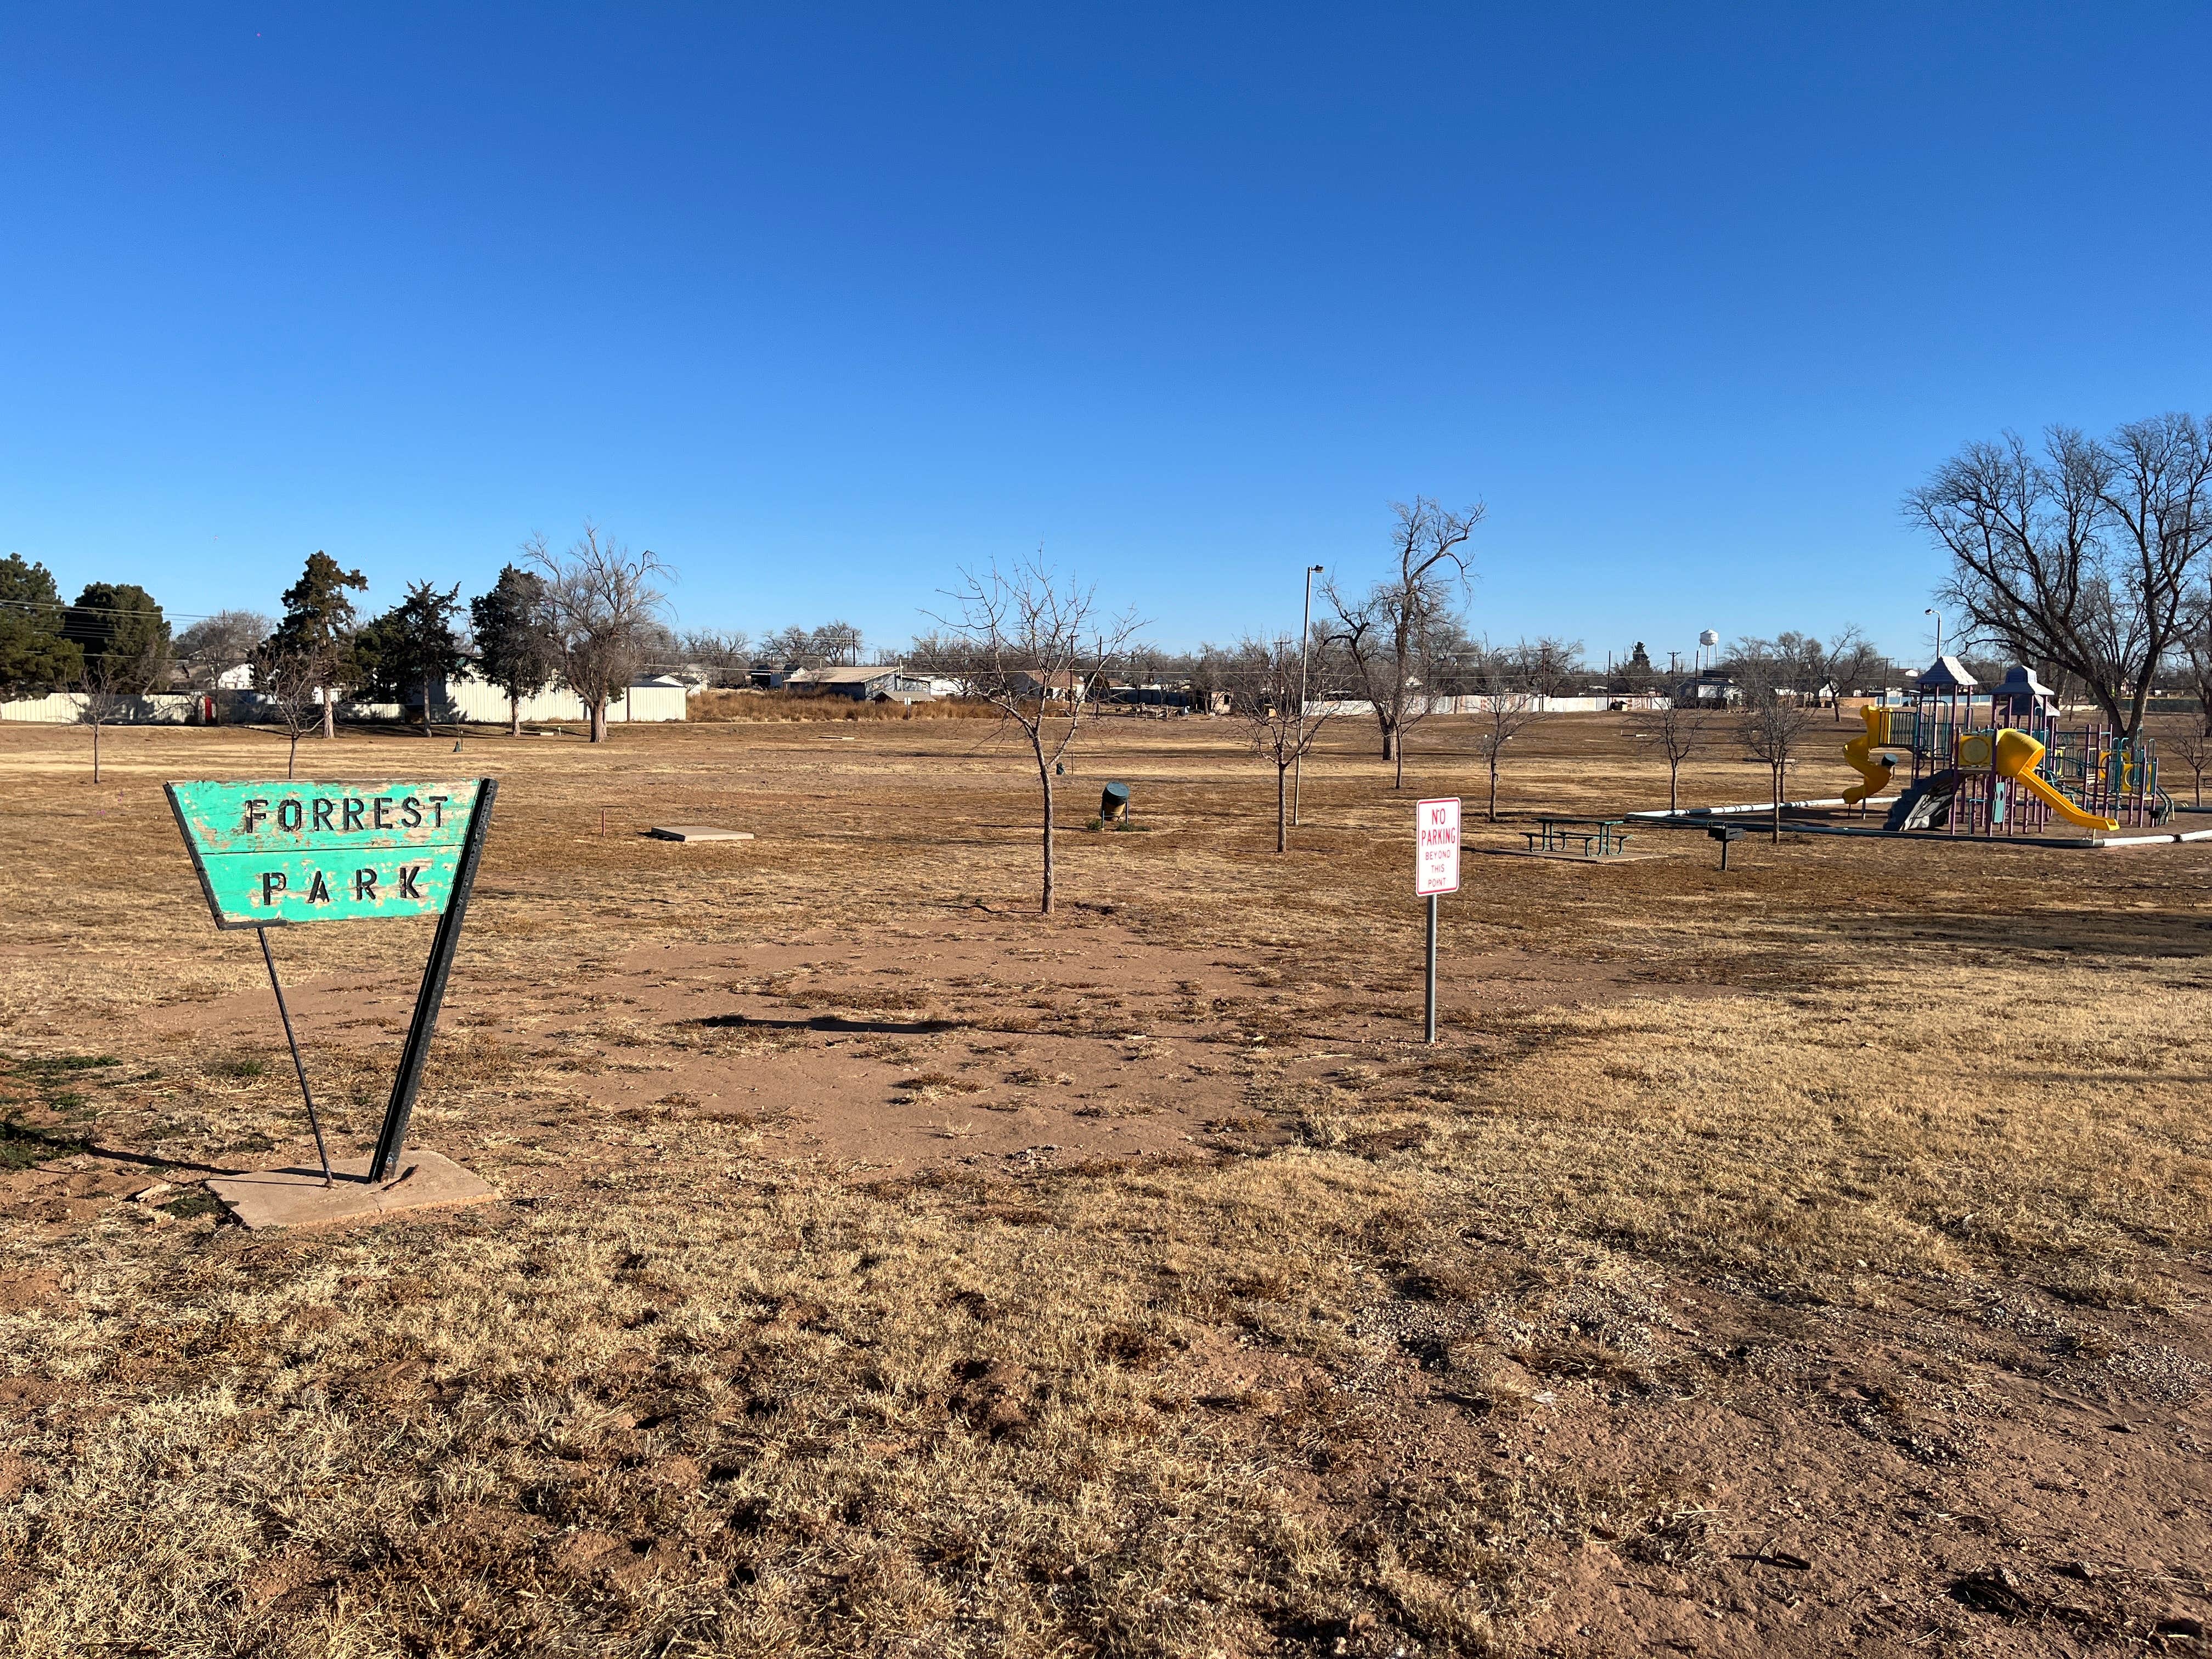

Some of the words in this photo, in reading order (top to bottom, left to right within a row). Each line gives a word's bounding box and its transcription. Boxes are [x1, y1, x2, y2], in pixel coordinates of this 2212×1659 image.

[245, 796, 448, 833] FORREST
[1432, 808, 1446, 825] NO
[1421, 827, 1455, 846] PARKING
[1425, 850, 1451, 860] BEYOND
[1431, 864, 1444, 873] THIS
[262, 866, 420, 906] PARK
[1428, 878, 1446, 887] POINT
